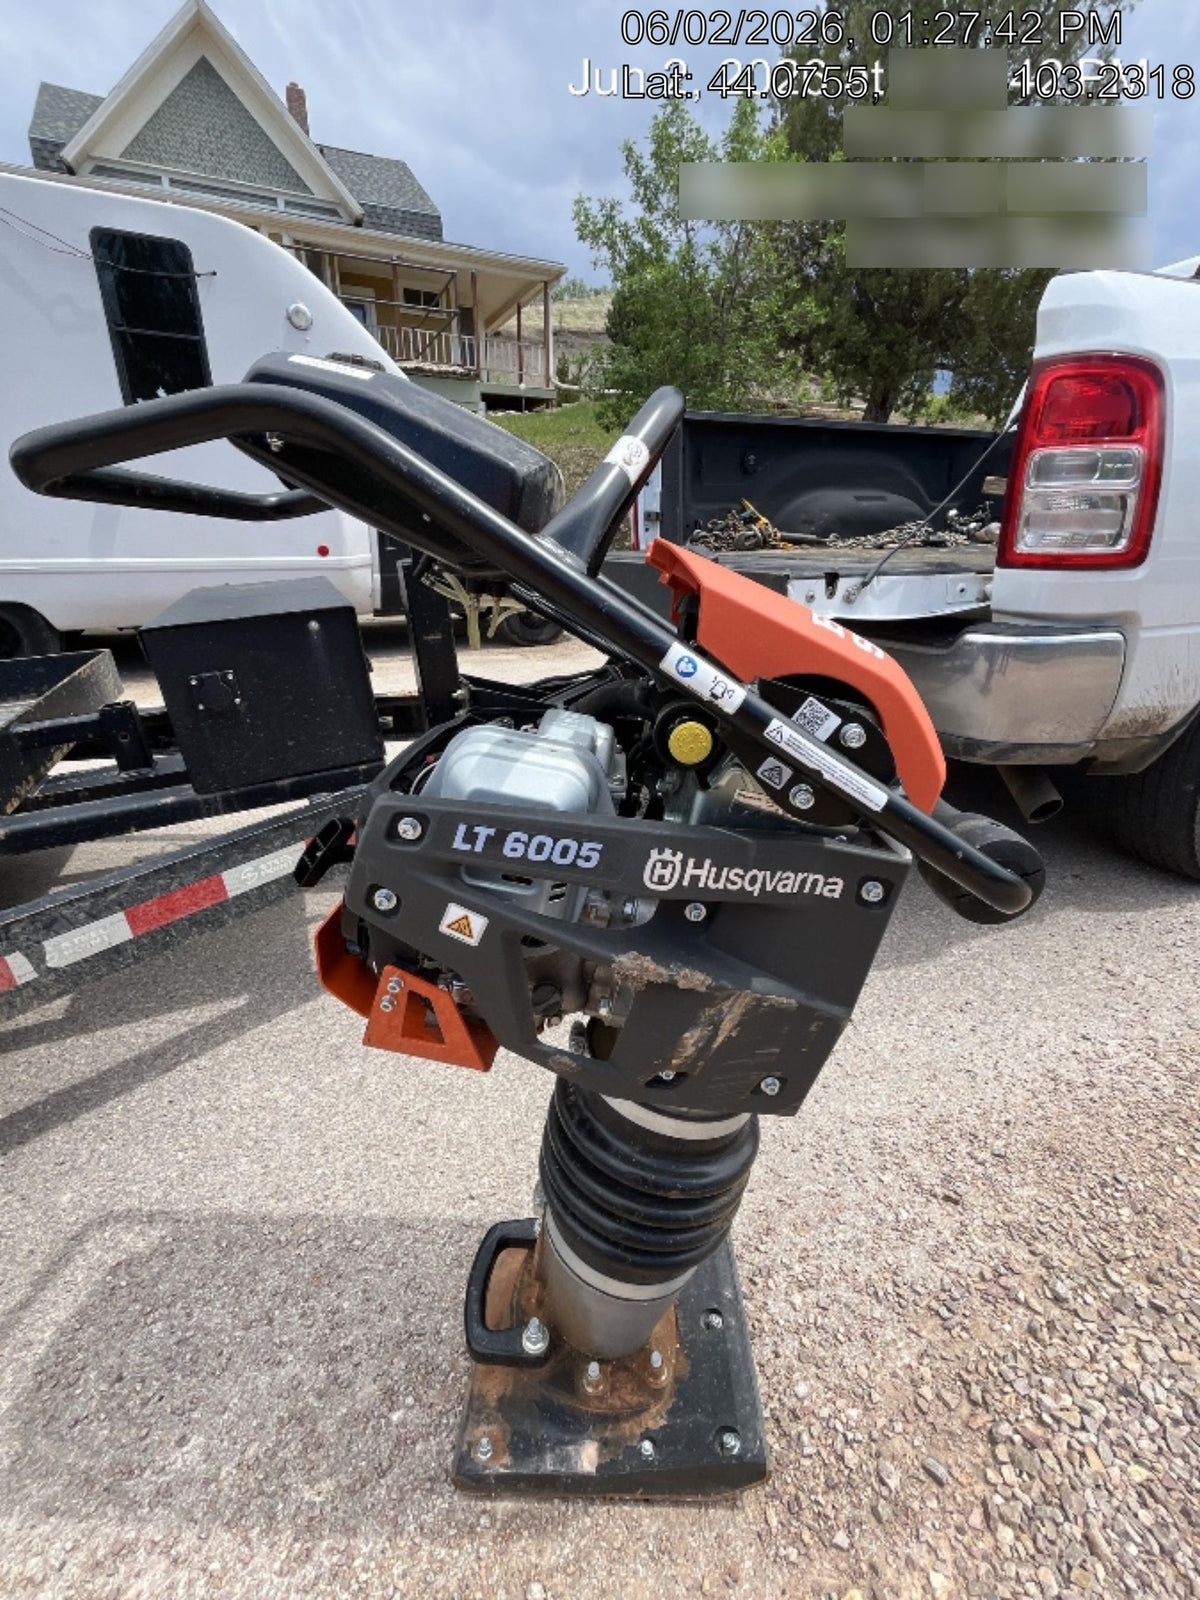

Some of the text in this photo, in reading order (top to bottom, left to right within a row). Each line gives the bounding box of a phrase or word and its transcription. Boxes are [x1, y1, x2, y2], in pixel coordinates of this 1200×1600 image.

[452, 823, 603, 869] LT 6005
[682, 858, 844, 899] Husqvarna
